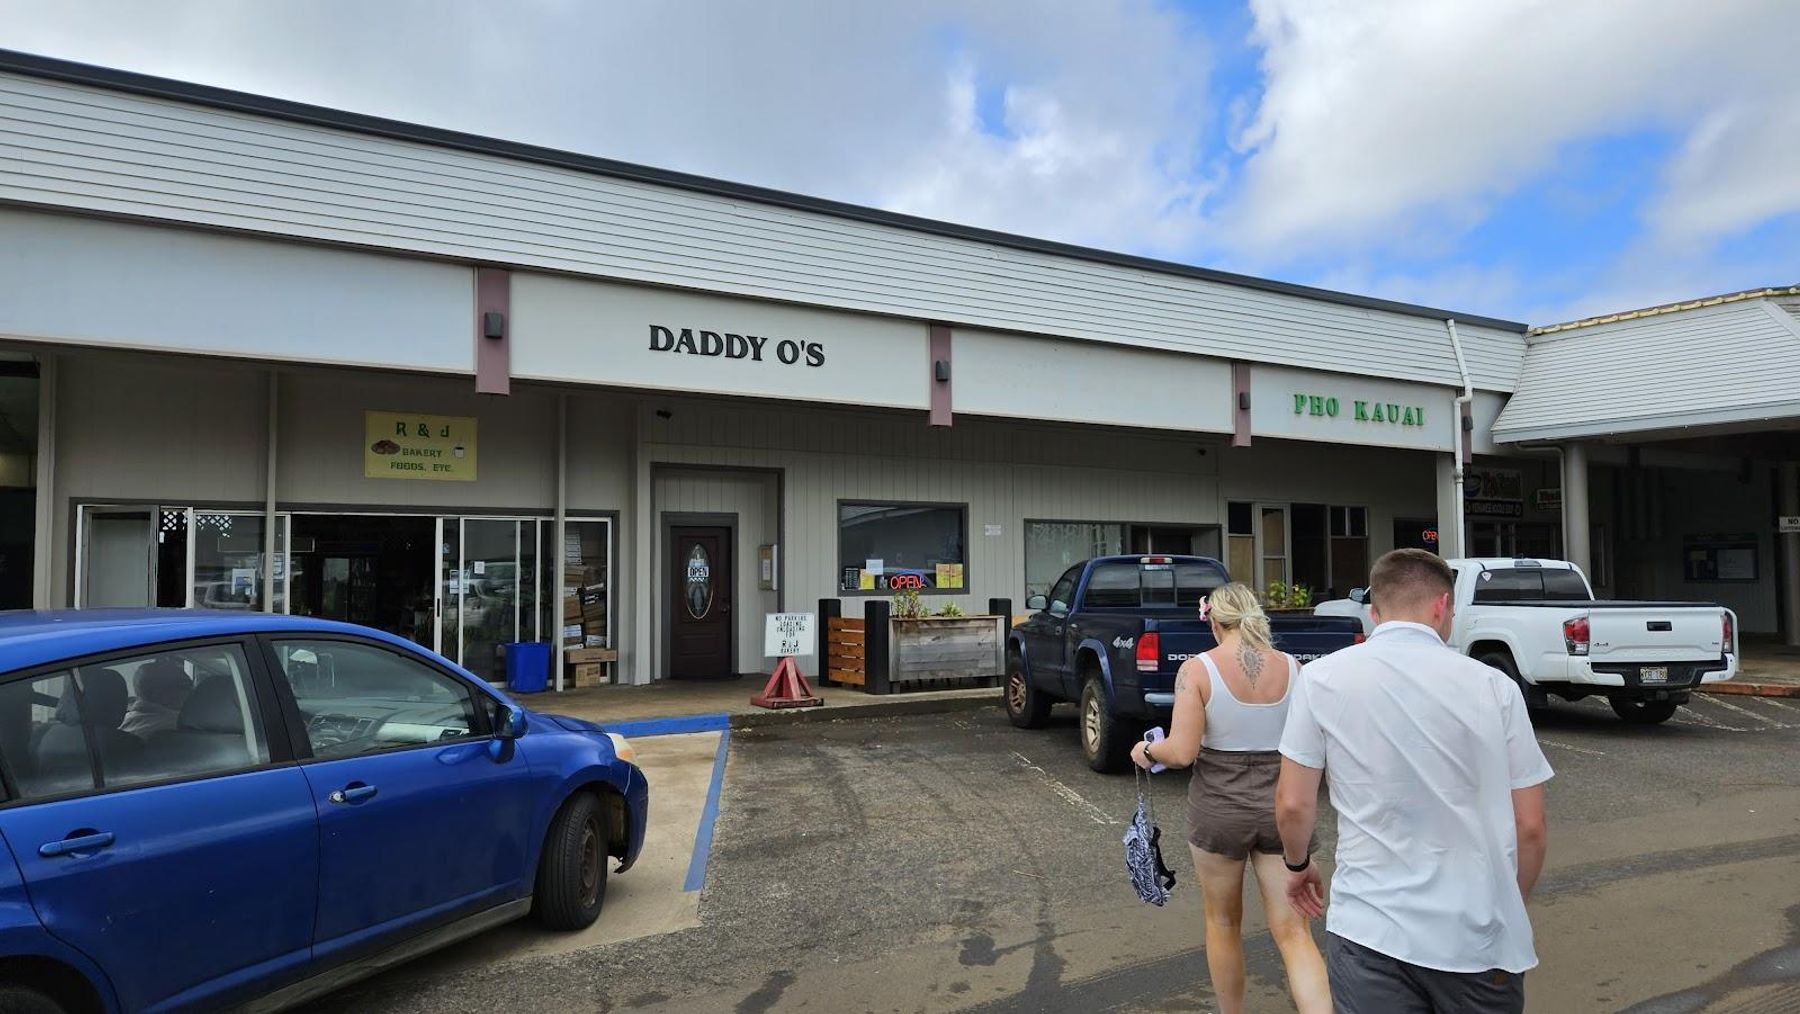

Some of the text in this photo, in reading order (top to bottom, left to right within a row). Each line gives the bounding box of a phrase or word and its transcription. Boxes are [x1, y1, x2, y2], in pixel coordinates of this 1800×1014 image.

[649, 325, 825, 367] DADDY O'S
[1293, 394, 1424, 426] PHO KAUAI
[396, 422, 450, 438] R & J
[402, 448, 442, 458] BAKERY
[890, 575, 926, 590] OPEN
[1112, 636, 1134, 650] 4x4
